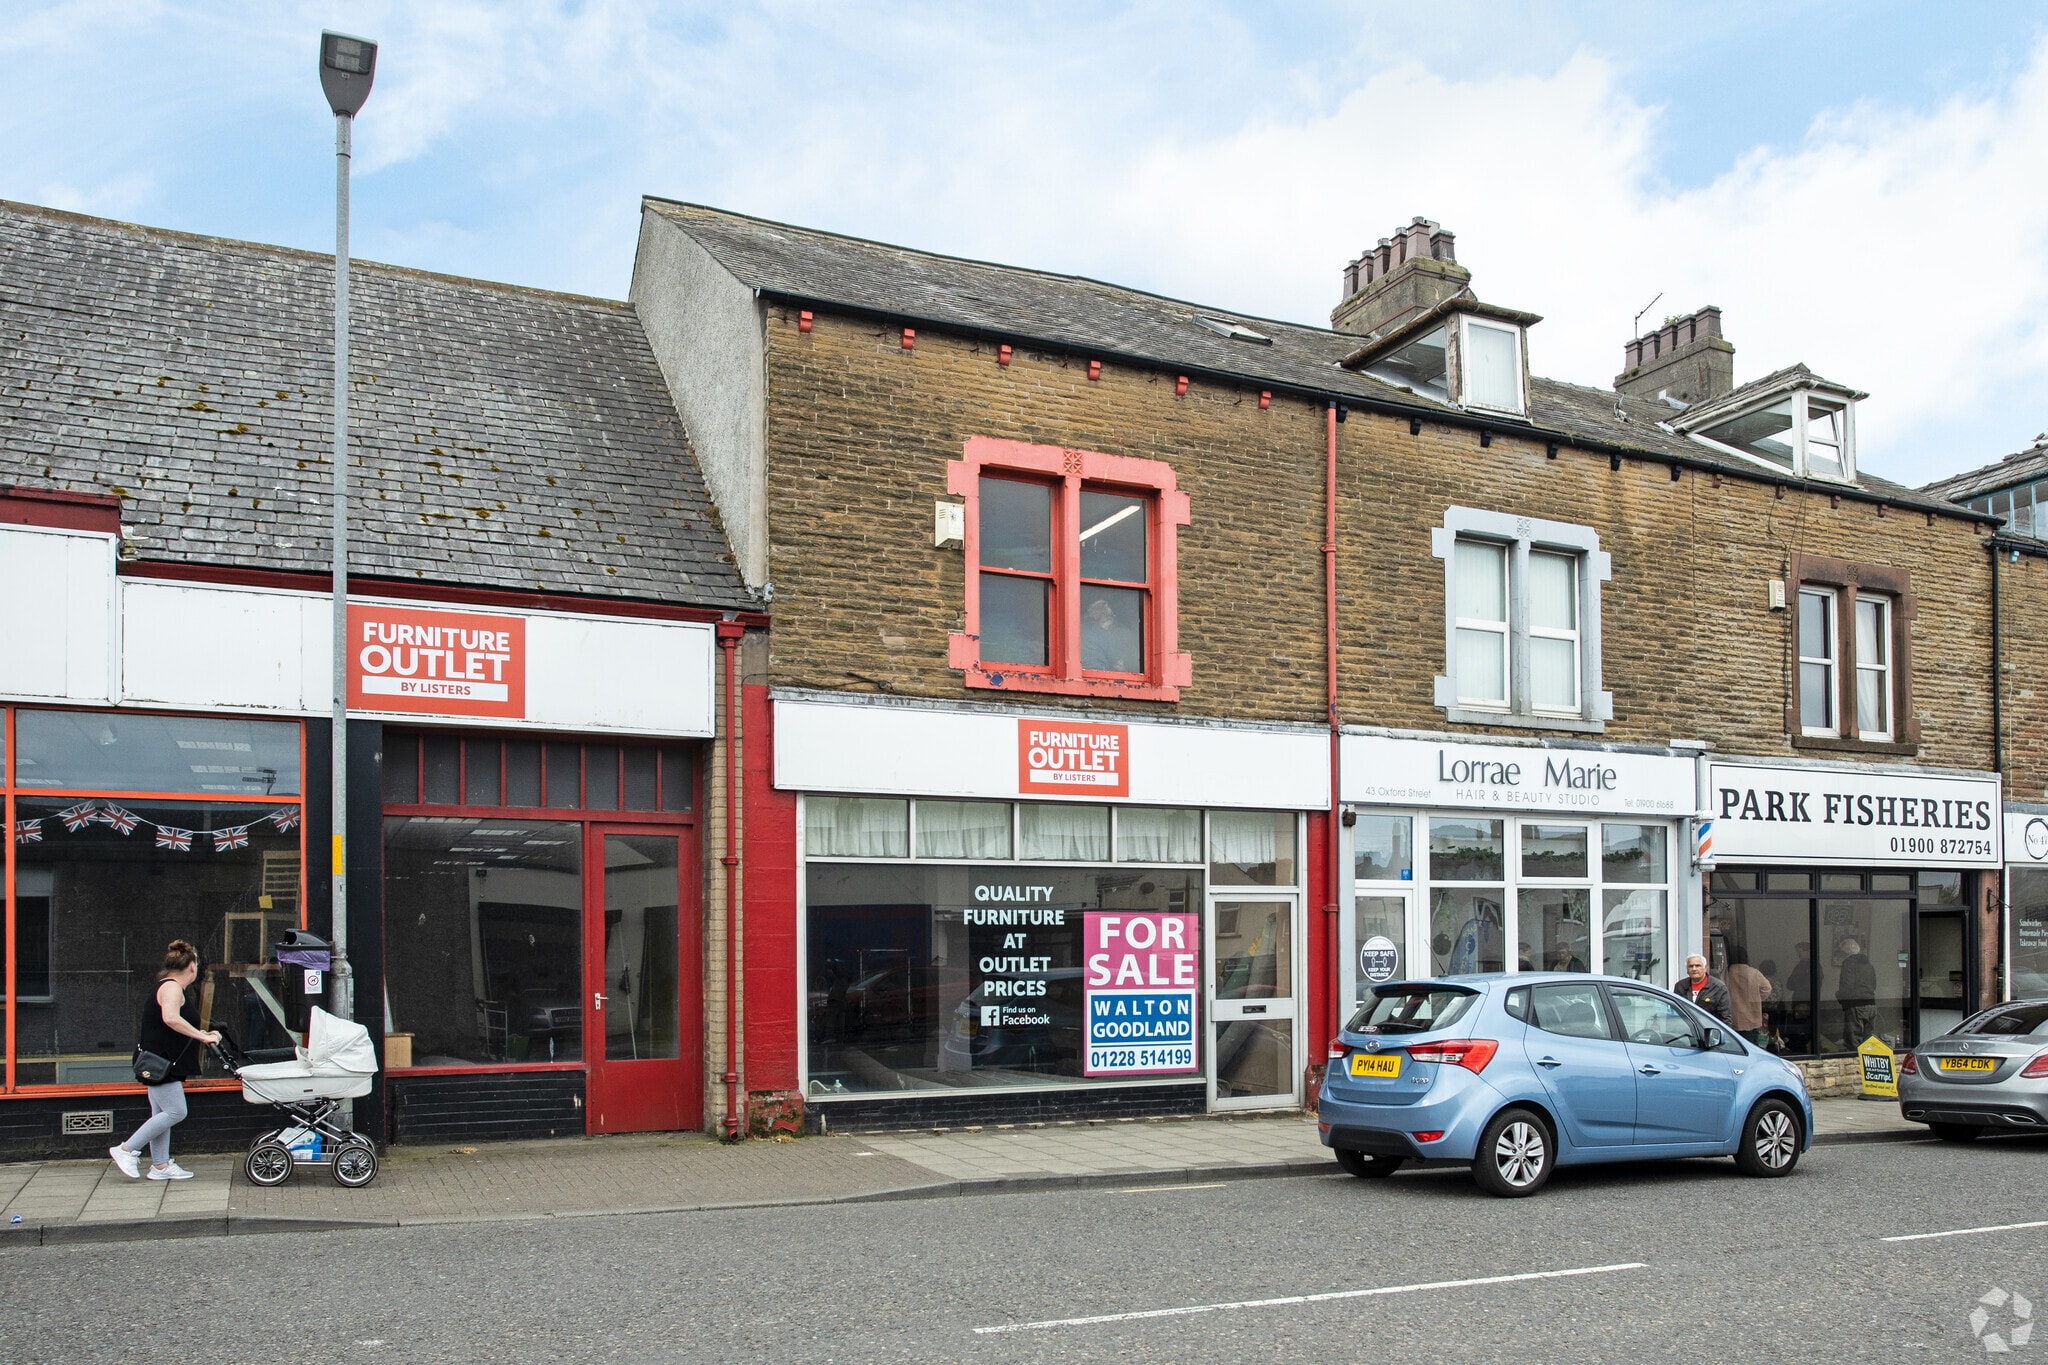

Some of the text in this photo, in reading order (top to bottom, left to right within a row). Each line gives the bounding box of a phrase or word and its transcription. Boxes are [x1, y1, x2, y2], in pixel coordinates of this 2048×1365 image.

[362, 621, 510, 652] FURNITURE
[359, 644, 510, 681] OUTLET
[400, 682, 471, 696] BY LISTERS
[1029, 730, 1119, 750] FURNITURE
[1028, 747, 1120, 771] OUTLET
[1053, 773, 1096, 782] BY LISTERS
[1439, 749, 1617, 791] Lorrae Marie
[1365, 786, 1432, 798] 43 Oxford Street
[1456, 789, 1600, 806] HAIR & BEAUTY STUDIO
[1719, 788, 1992, 831] PARK FISHERIES
[1890, 837, 1992, 855] 01900 872754
[974, 885, 1054, 902] QUALITY
[963, 909, 1065, 925] FURNITURE
[1003, 933, 1027, 949] AT
[1099, 916, 1185, 949] FOR
[979, 956, 1051, 973] OUTLET
[1088, 954, 1195, 986] SALE
[984, 980, 1047, 997] PRICES
[1002, 1006, 1017, 1014] Find
[1094, 1000, 1189, 1016] WALTON
[1002, 1014, 1050, 1025] Facebook
[1093, 1021, 1190, 1038] GOODLAND
[1091, 1049, 1192, 1068] 01228 514199
[1356, 1059, 1395, 1072] PY14 HAU
[1863, 1055, 1889, 1069] WHITBY
[1945, 1058, 1991, 1070] YB64 CDK
